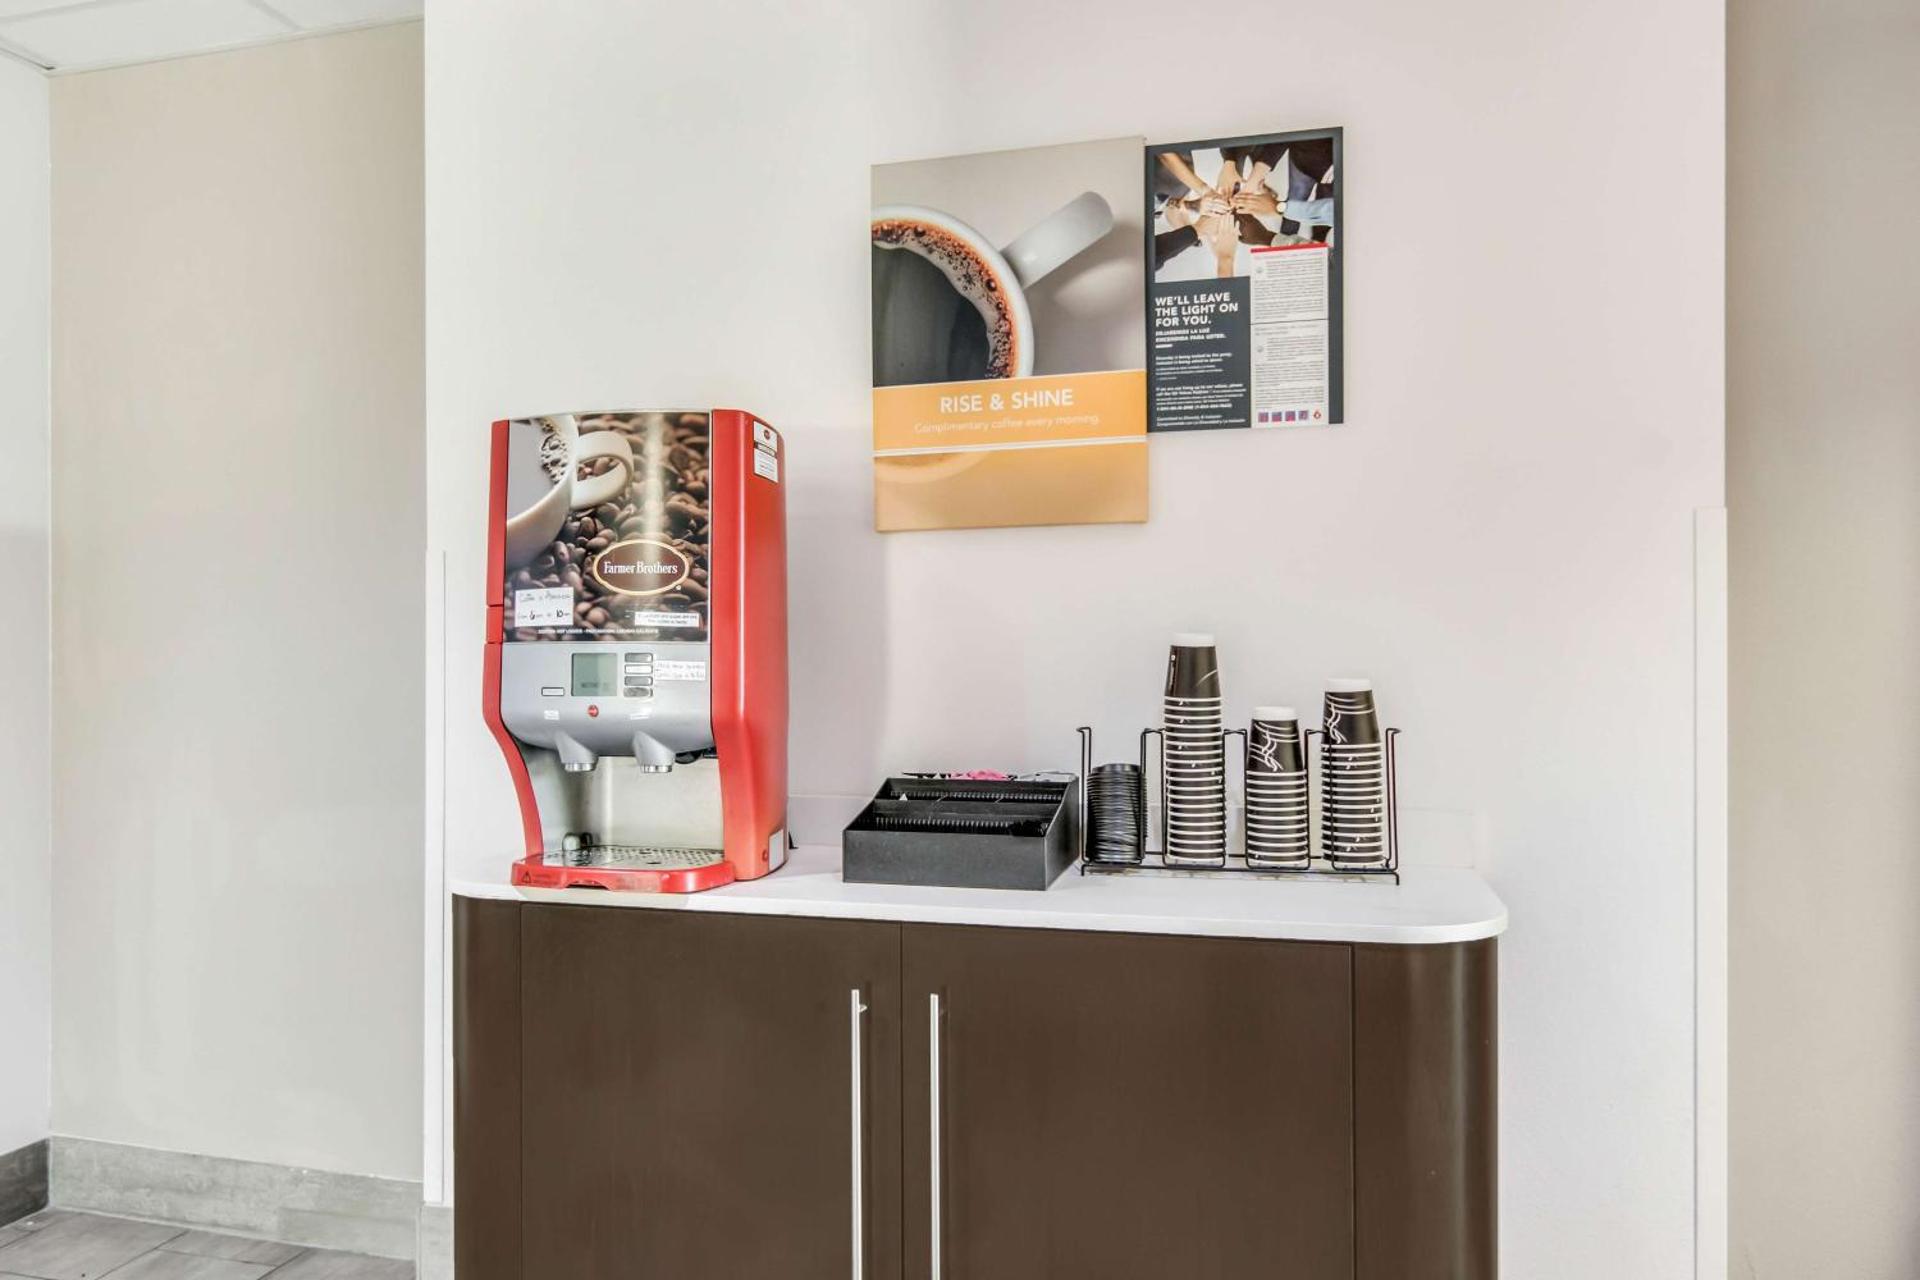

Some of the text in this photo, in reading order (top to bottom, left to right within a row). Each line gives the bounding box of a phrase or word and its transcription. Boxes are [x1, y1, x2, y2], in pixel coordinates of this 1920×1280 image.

[1155, 293, 1230, 306] WE'LL LEAVE
[1155, 302, 1239, 317] THE LIGHT ON
[1155, 315, 1212, 327] FOR YOU.
[940, 388, 1074, 413] RISE & SHINE
[914, 419, 989, 434] Complimentary
[991, 418, 1023, 430] coffee
[1026, 417, 1053, 429] every
[603, 560, 678, 574] Farmer Brothers
